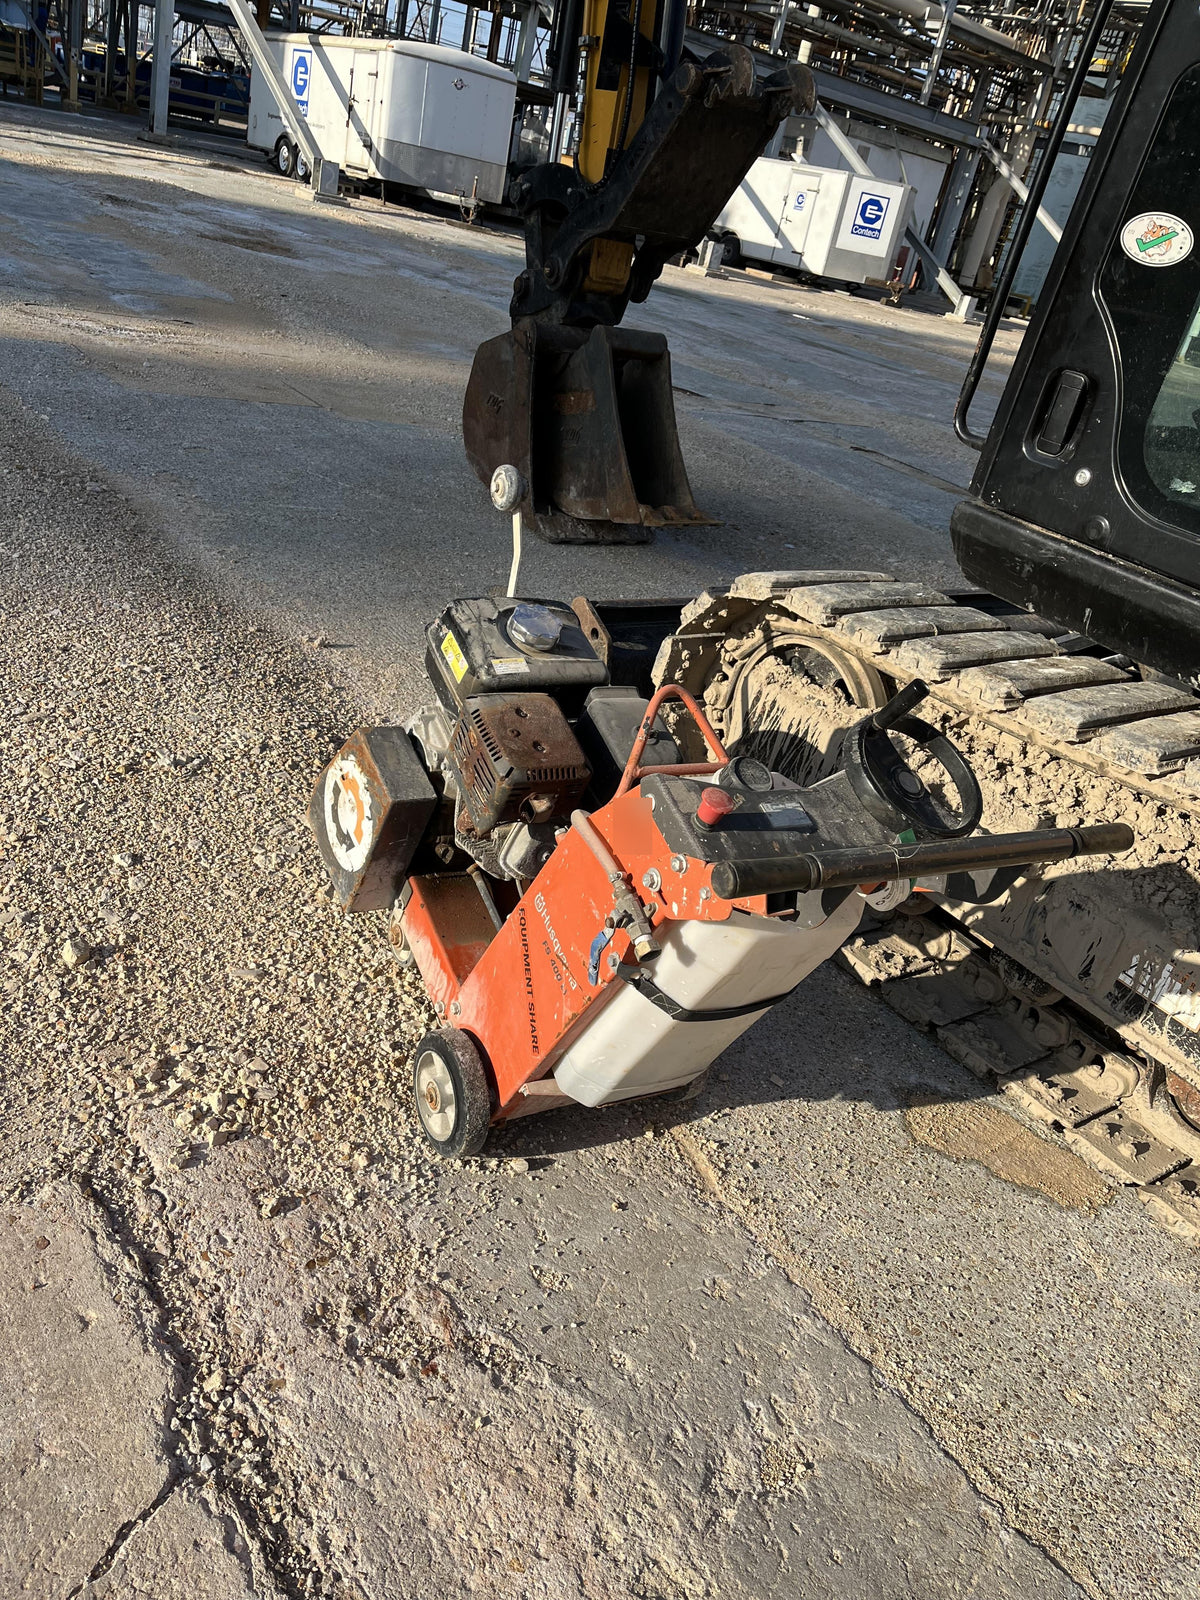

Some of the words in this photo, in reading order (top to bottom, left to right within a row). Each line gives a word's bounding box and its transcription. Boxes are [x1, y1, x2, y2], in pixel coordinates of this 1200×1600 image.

[852, 225, 880, 239] Contech
[518, 907, 534, 998] EQUIPMENT
[528, 1002, 540, 1054] SHARE
[542, 940, 551, 955] FS
[550, 959, 563, 982] 400
